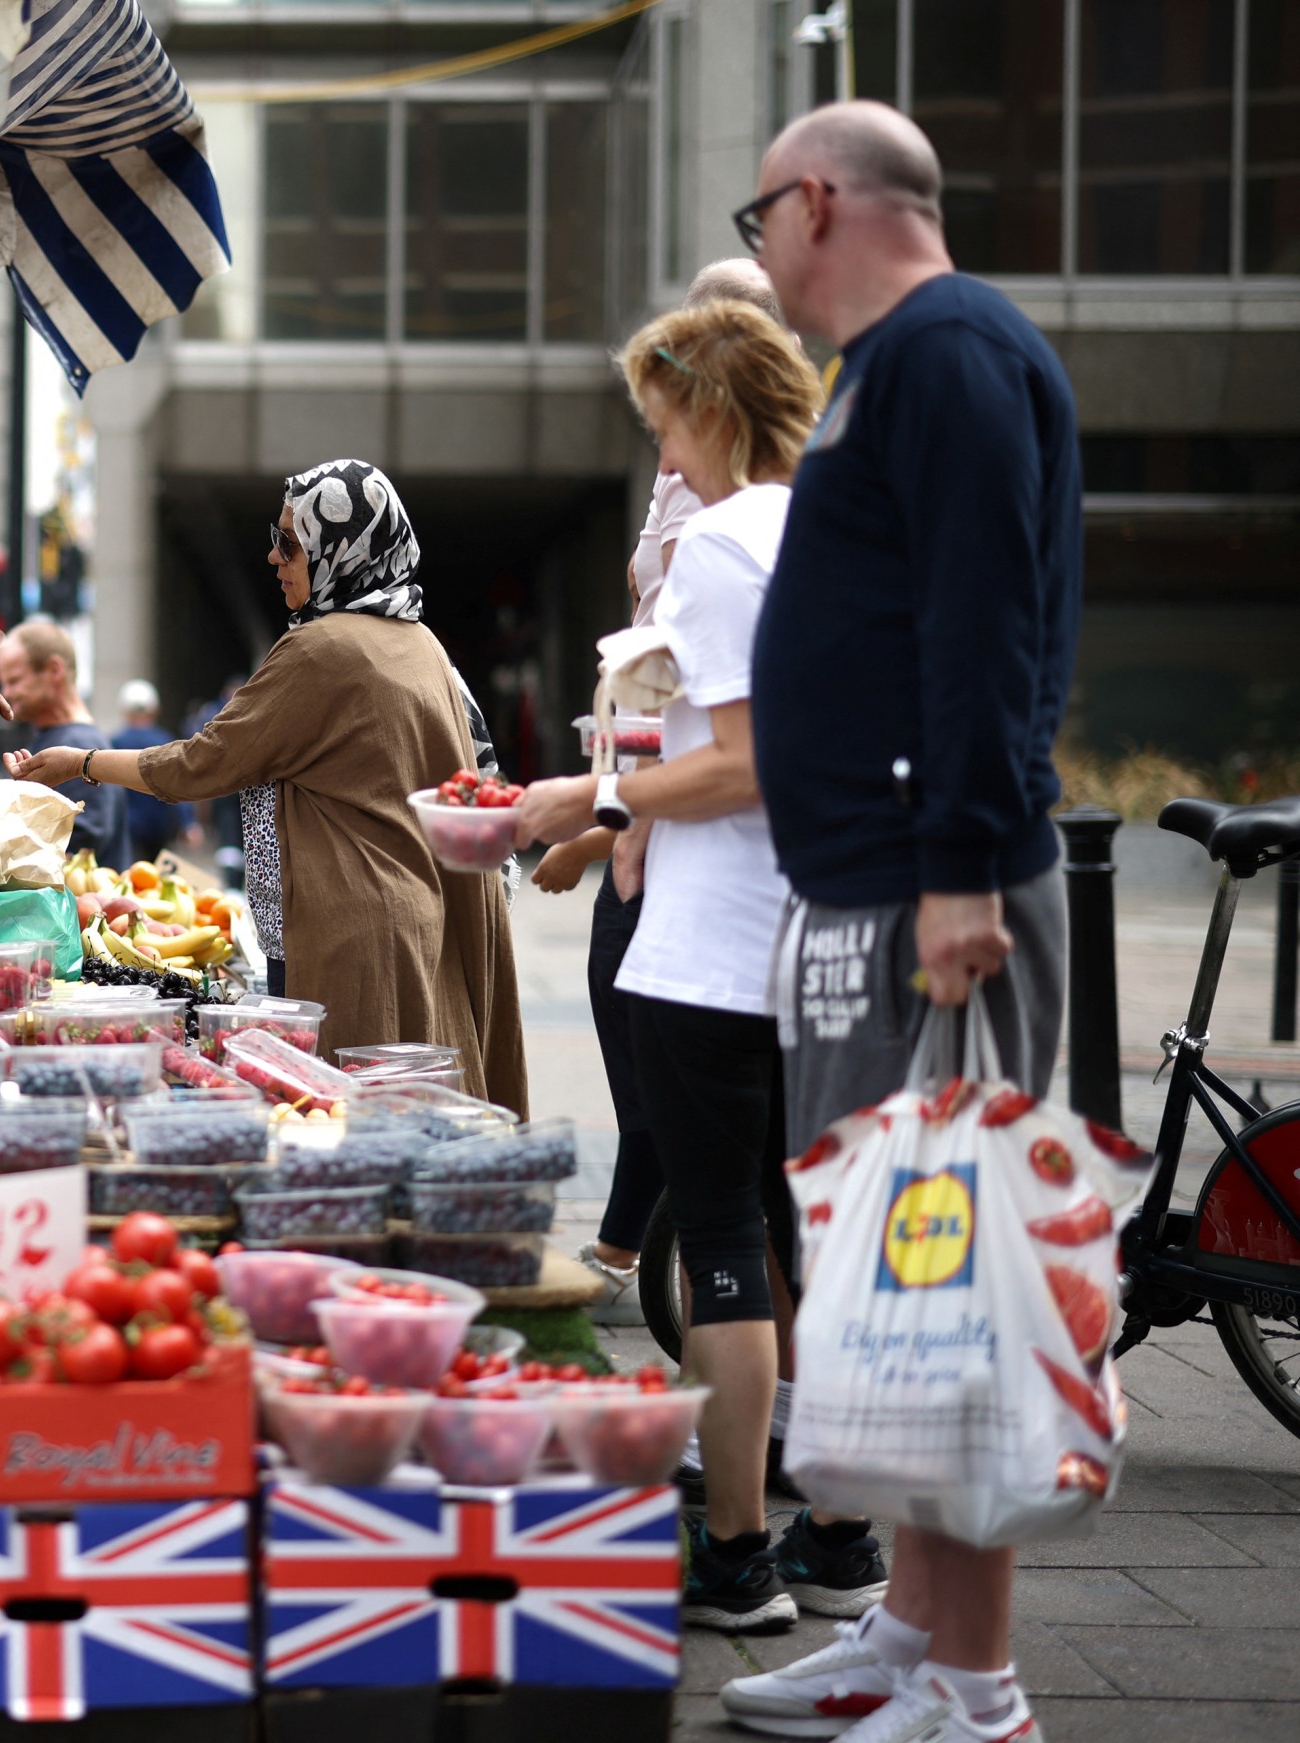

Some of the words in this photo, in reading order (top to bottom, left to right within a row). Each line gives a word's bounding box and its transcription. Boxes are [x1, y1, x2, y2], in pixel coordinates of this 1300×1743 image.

[1243, 1286, 1297, 1315] 51890
[912, 1310, 998, 1363] quality
[2, 1419, 135, 1490] Royal
[133, 1426, 223, 1470] Vine
